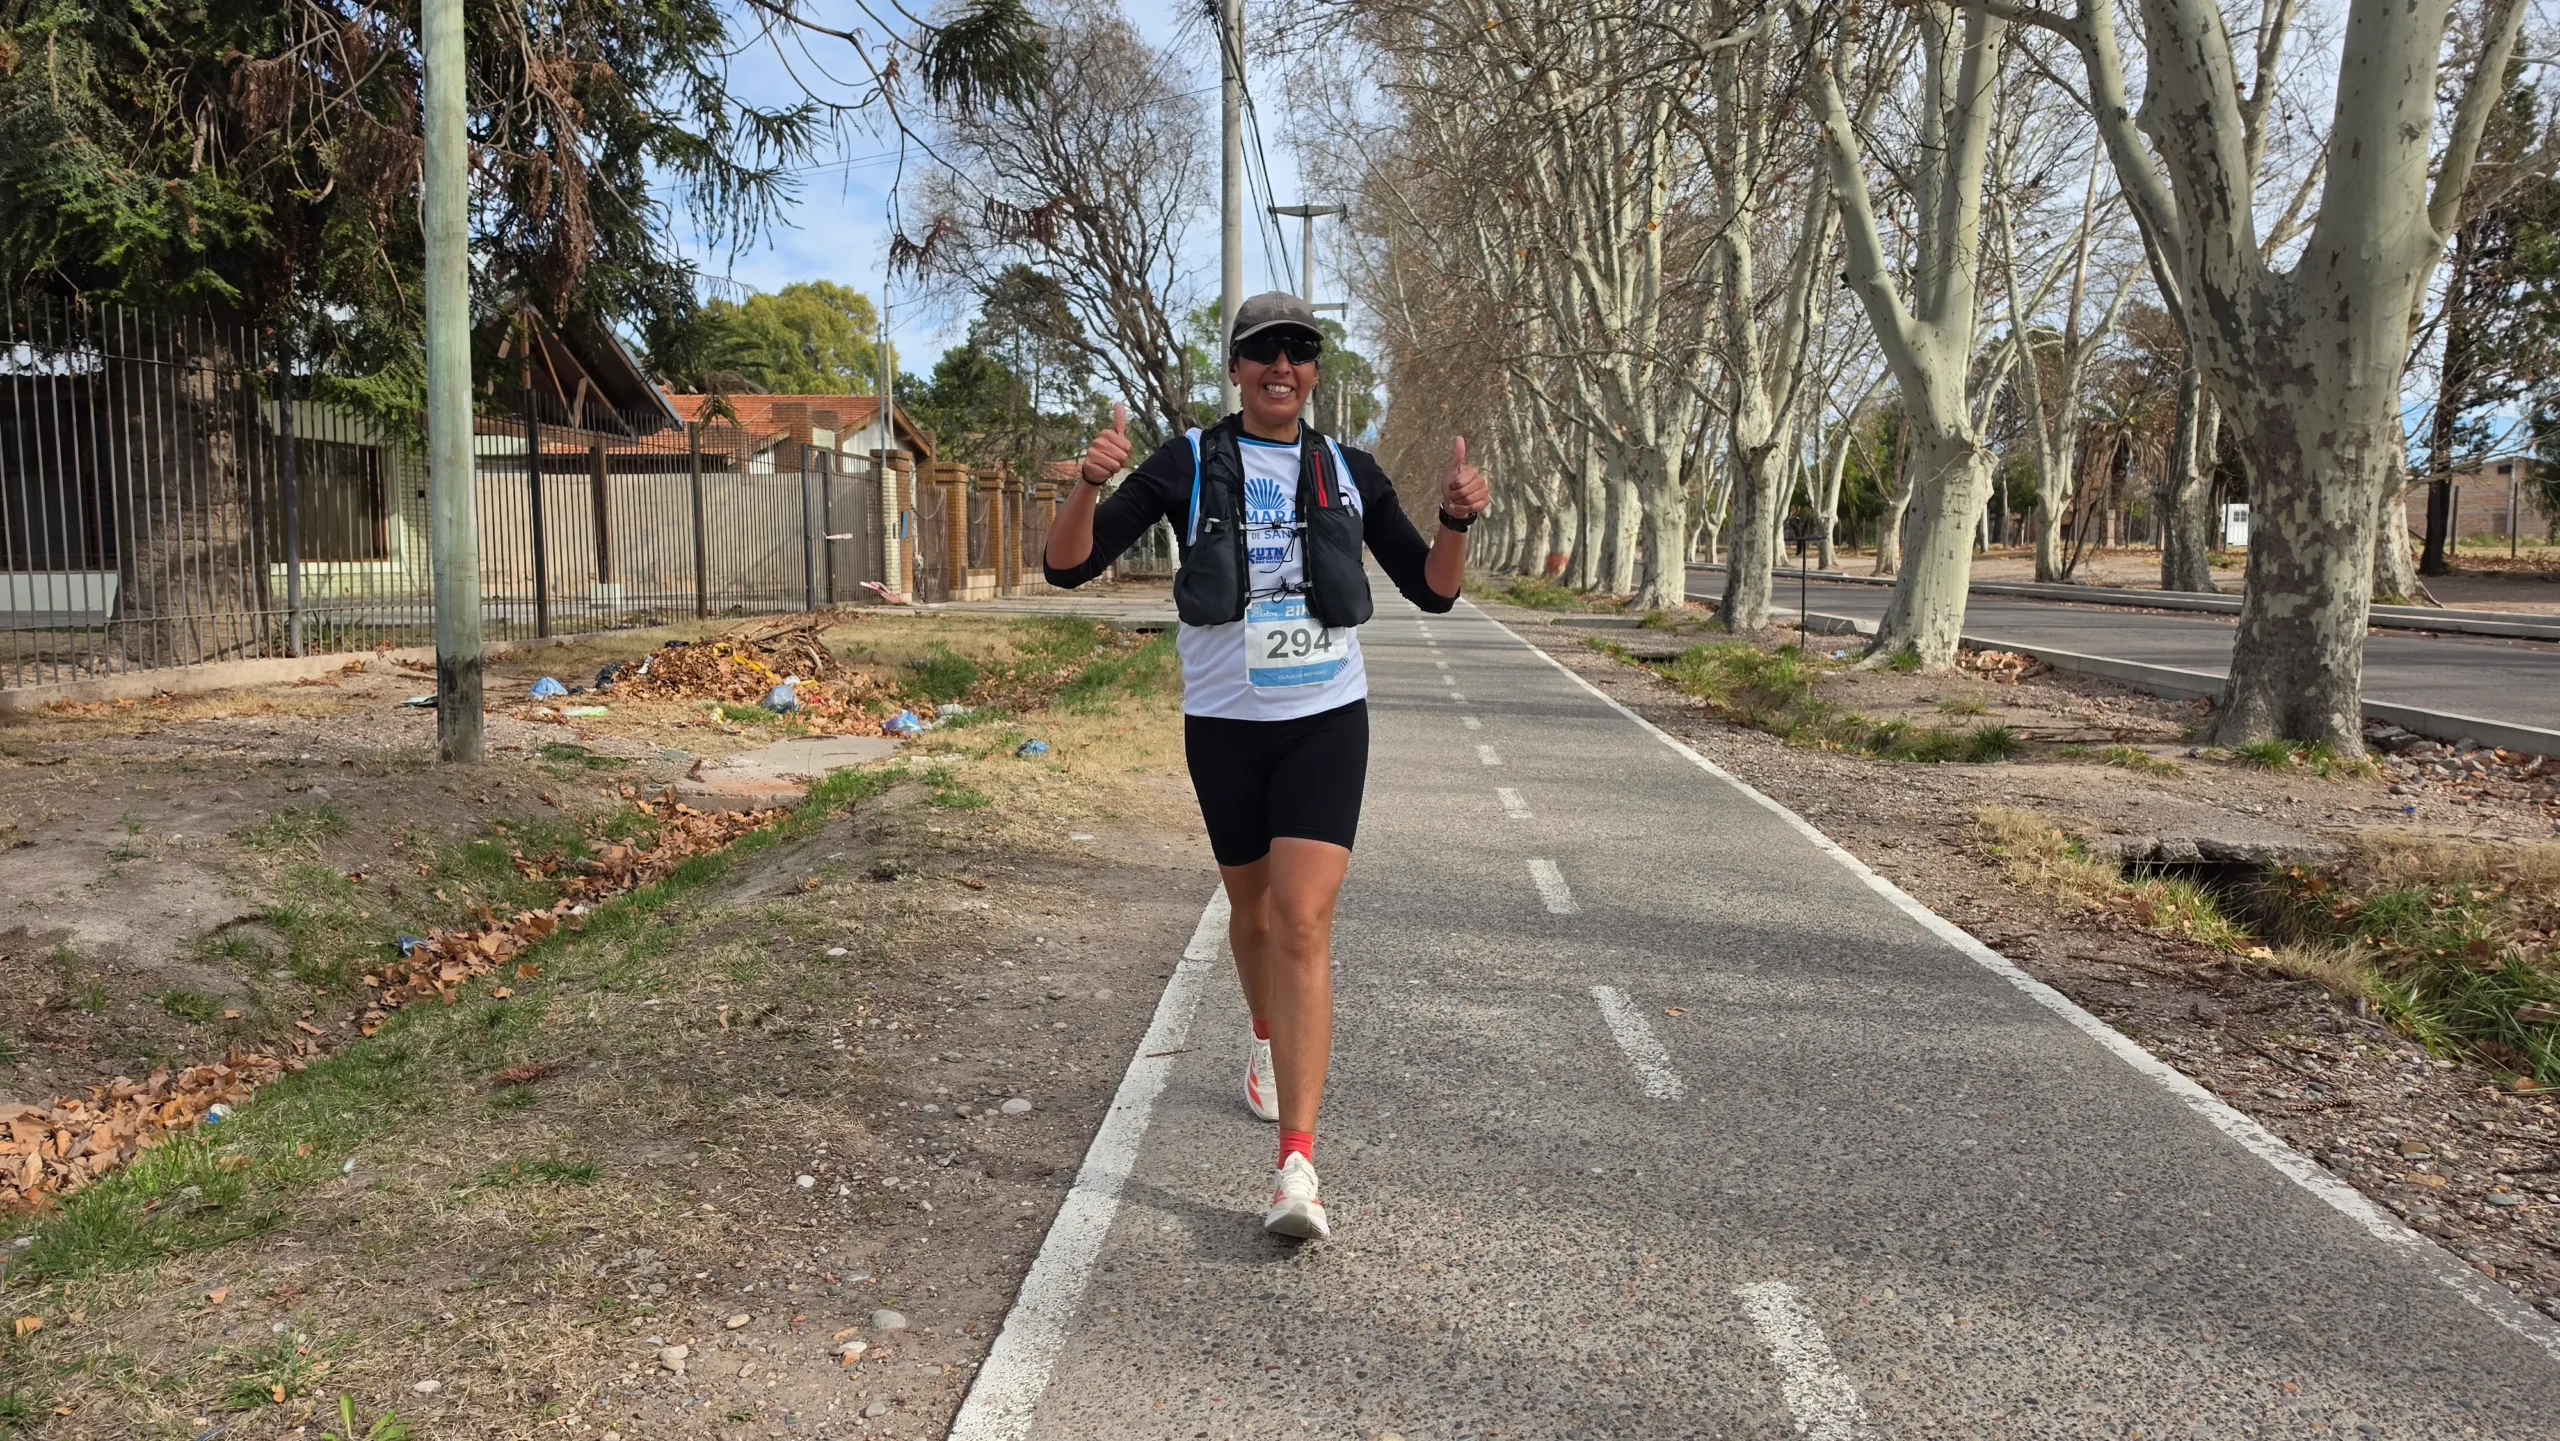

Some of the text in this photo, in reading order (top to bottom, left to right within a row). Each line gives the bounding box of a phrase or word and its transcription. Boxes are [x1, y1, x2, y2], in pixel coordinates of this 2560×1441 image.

[1251, 530, 1292, 540] DE SAN
[1255, 547, 1284, 556] UTN
[1266, 628, 1333, 659] 294
[1277, 669, 1328, 680] CLAUDIA MOYANO
